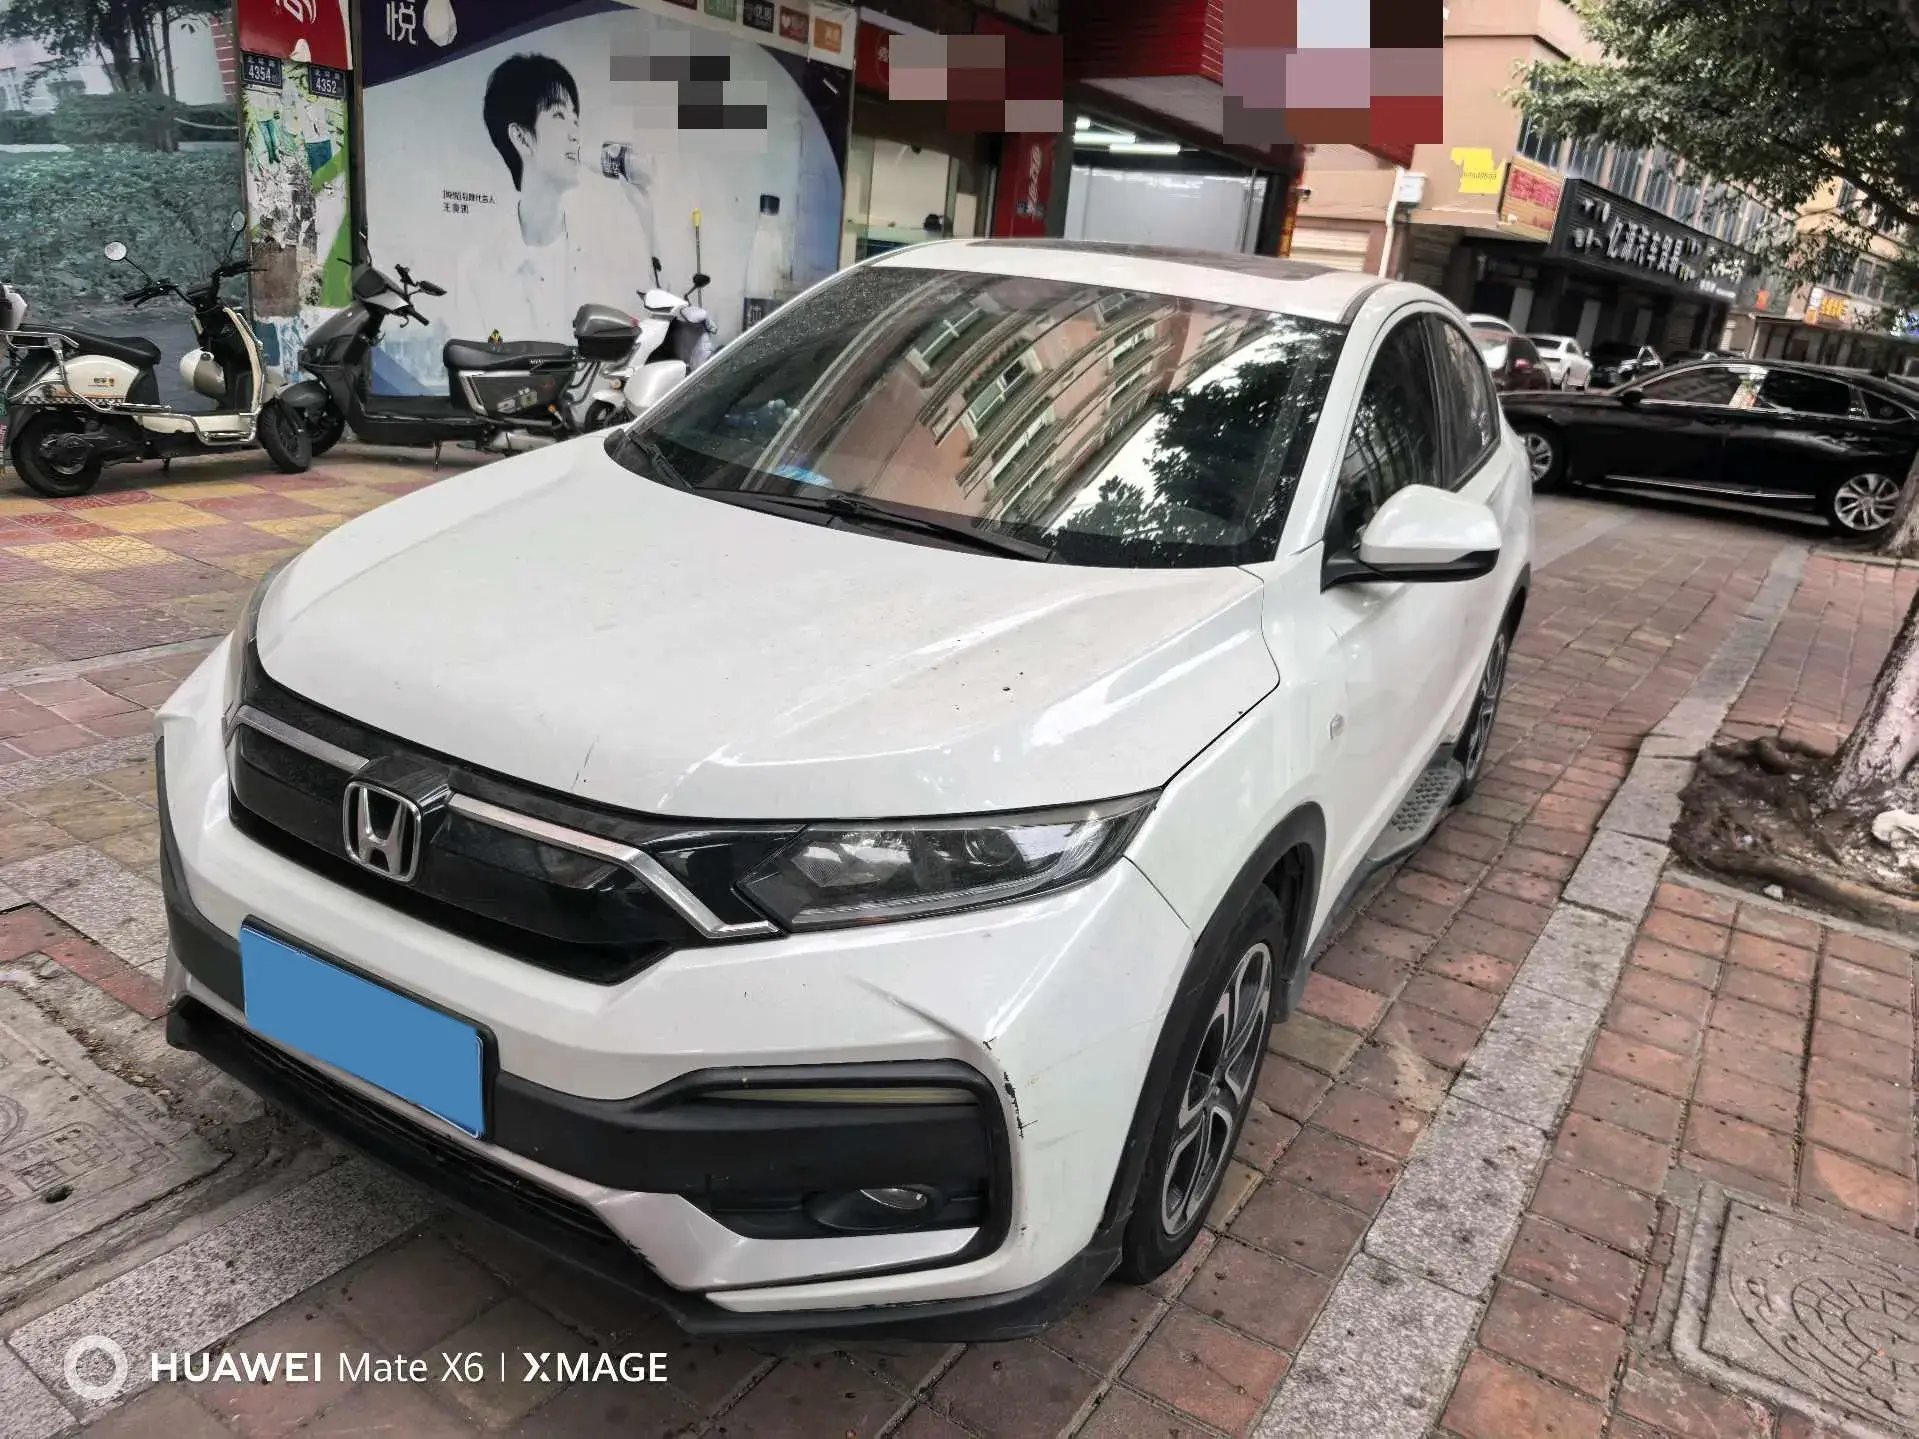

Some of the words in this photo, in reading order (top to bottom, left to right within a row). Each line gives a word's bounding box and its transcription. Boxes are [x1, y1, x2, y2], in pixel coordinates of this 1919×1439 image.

[386, 1, 418, 45] 悦
[248, 64, 272, 82] 4354
[315, 77, 338, 94] 4352
